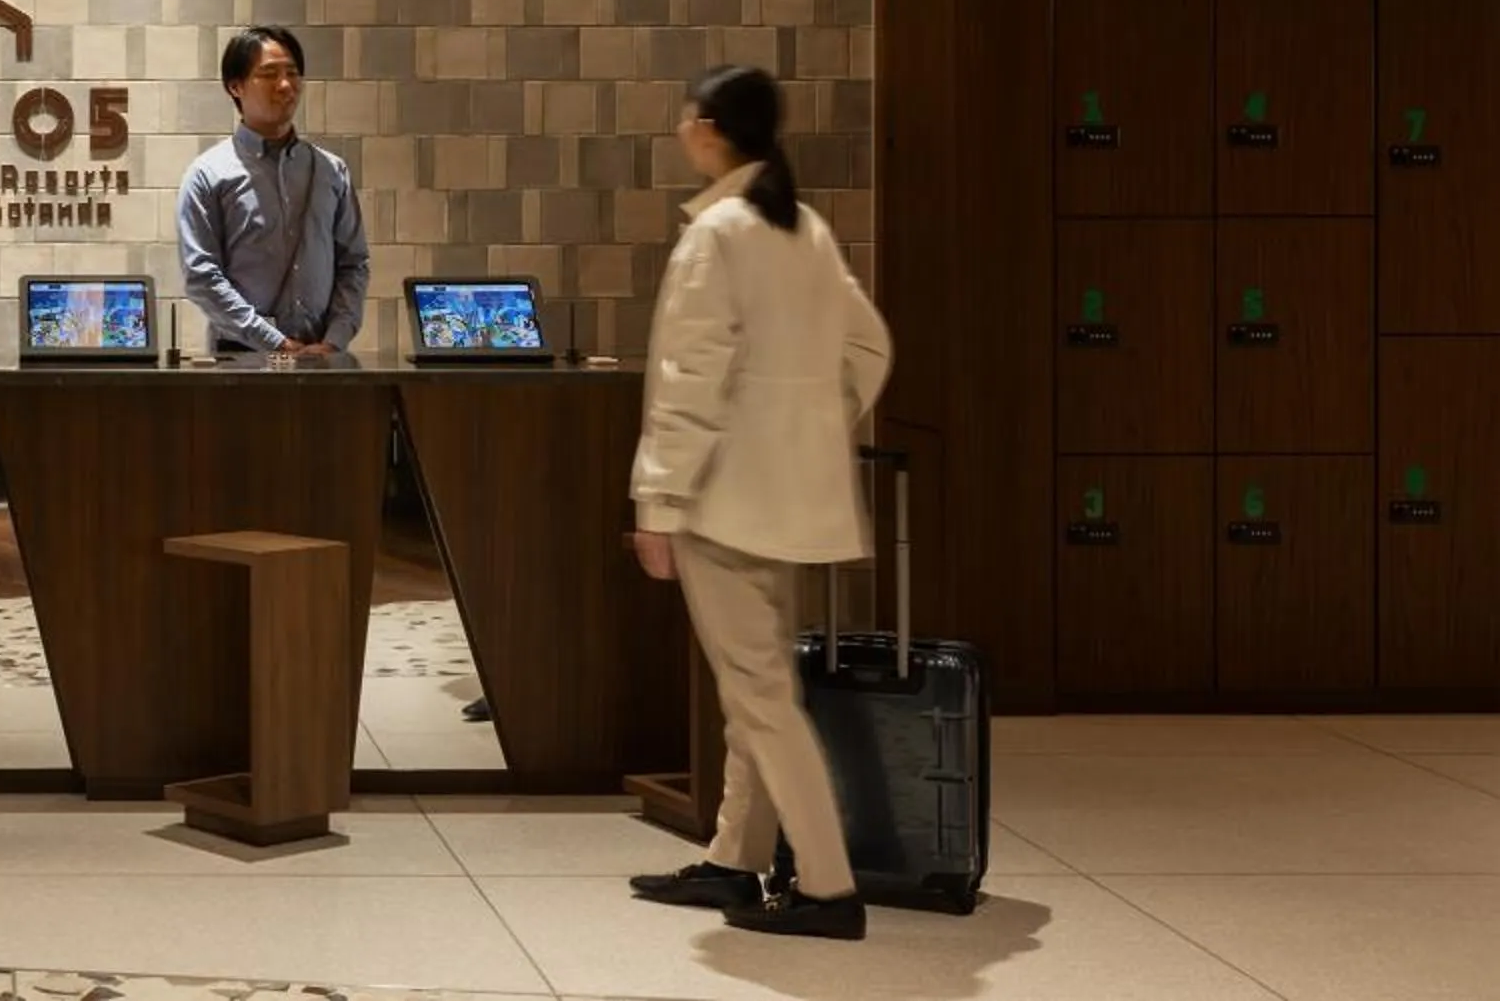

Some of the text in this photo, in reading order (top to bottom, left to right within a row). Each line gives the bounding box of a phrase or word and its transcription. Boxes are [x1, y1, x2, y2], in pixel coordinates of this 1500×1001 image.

[1405, 108, 1427, 142] 7
[0, 165, 129, 195] Resorts
[1083, 489, 1104, 520] 3
